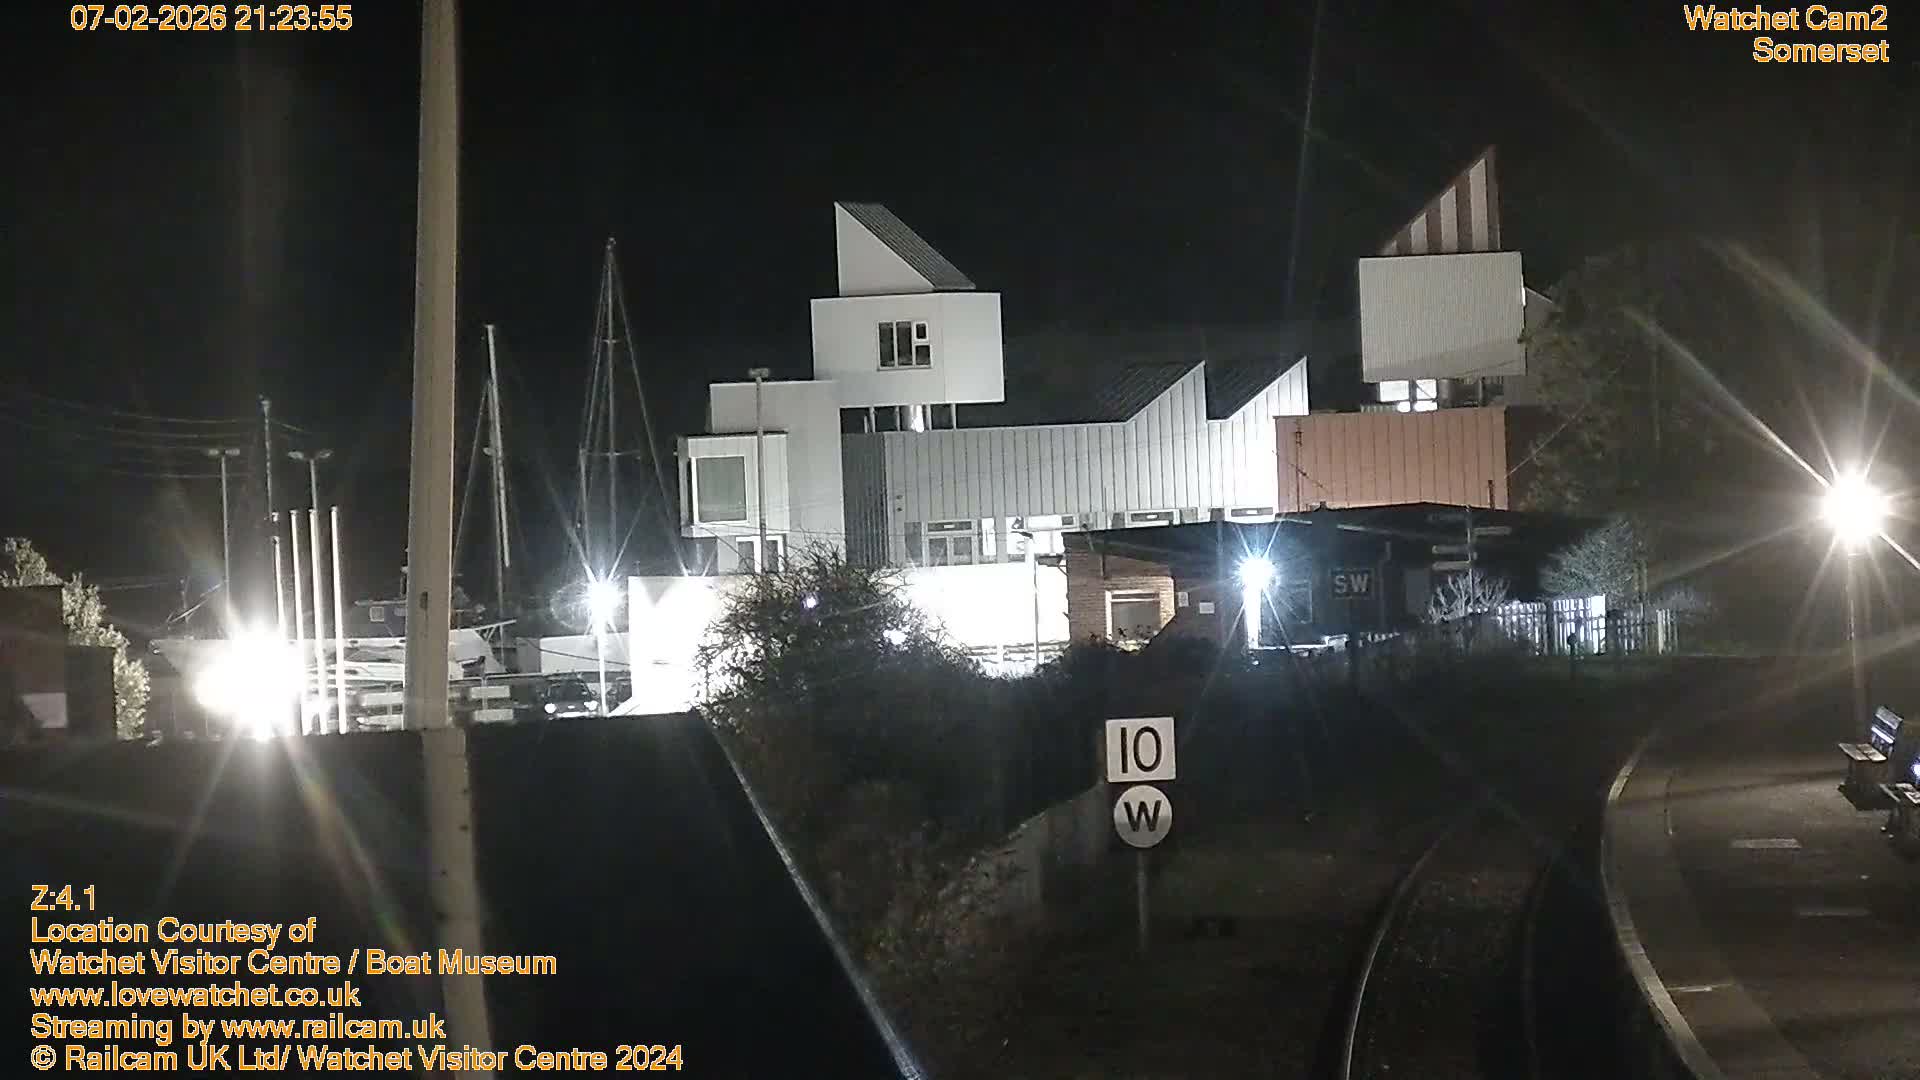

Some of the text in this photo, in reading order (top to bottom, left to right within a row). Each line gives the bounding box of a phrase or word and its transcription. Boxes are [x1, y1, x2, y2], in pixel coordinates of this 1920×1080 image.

[1334, 573, 1369, 594] SW
[1120, 726, 1162, 774] 10
[1123, 799, 1162, 833] W
